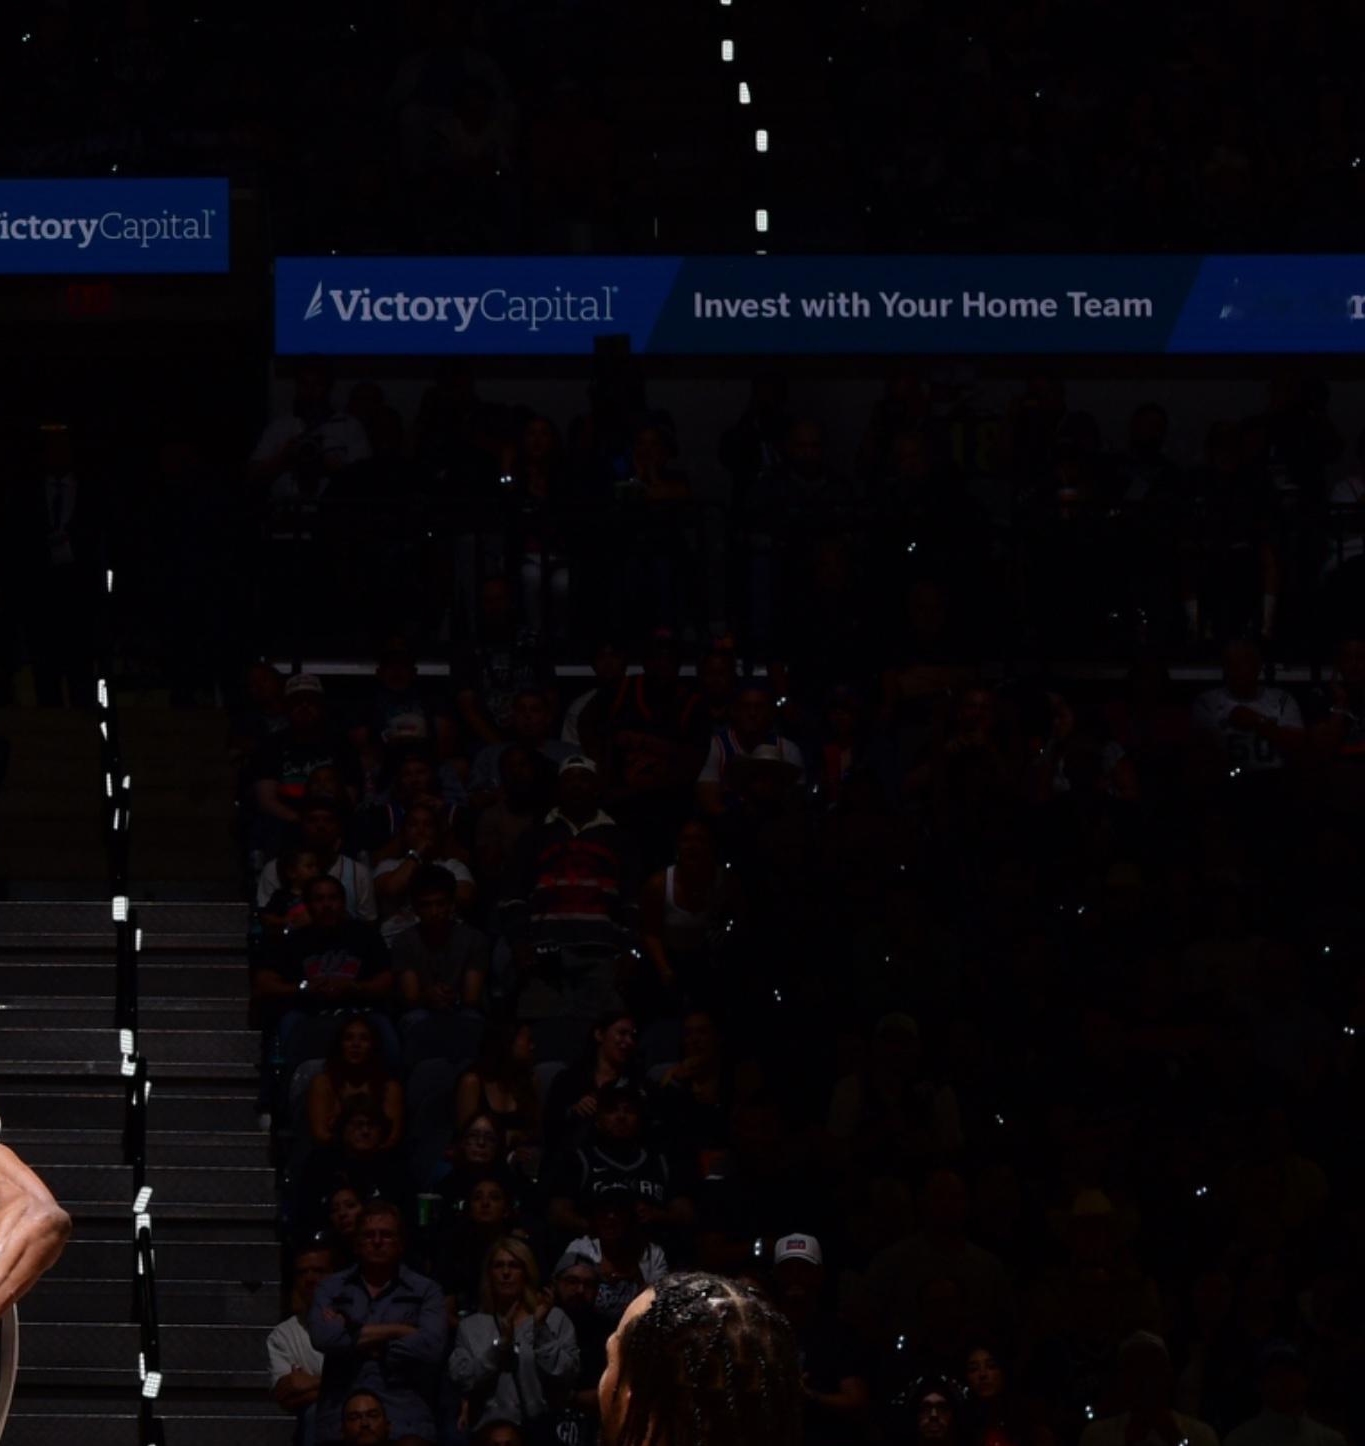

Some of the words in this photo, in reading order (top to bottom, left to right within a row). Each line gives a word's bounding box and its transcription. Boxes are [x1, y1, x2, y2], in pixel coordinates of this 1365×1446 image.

[336, 287, 615, 333] VictoryCapital
[693, 294, 791, 319] Invest
[801, 294, 872, 319] with
[880, 294, 956, 319] Your
[963, 294, 1060, 319] Home
[1067, 294, 1156, 319] Team
